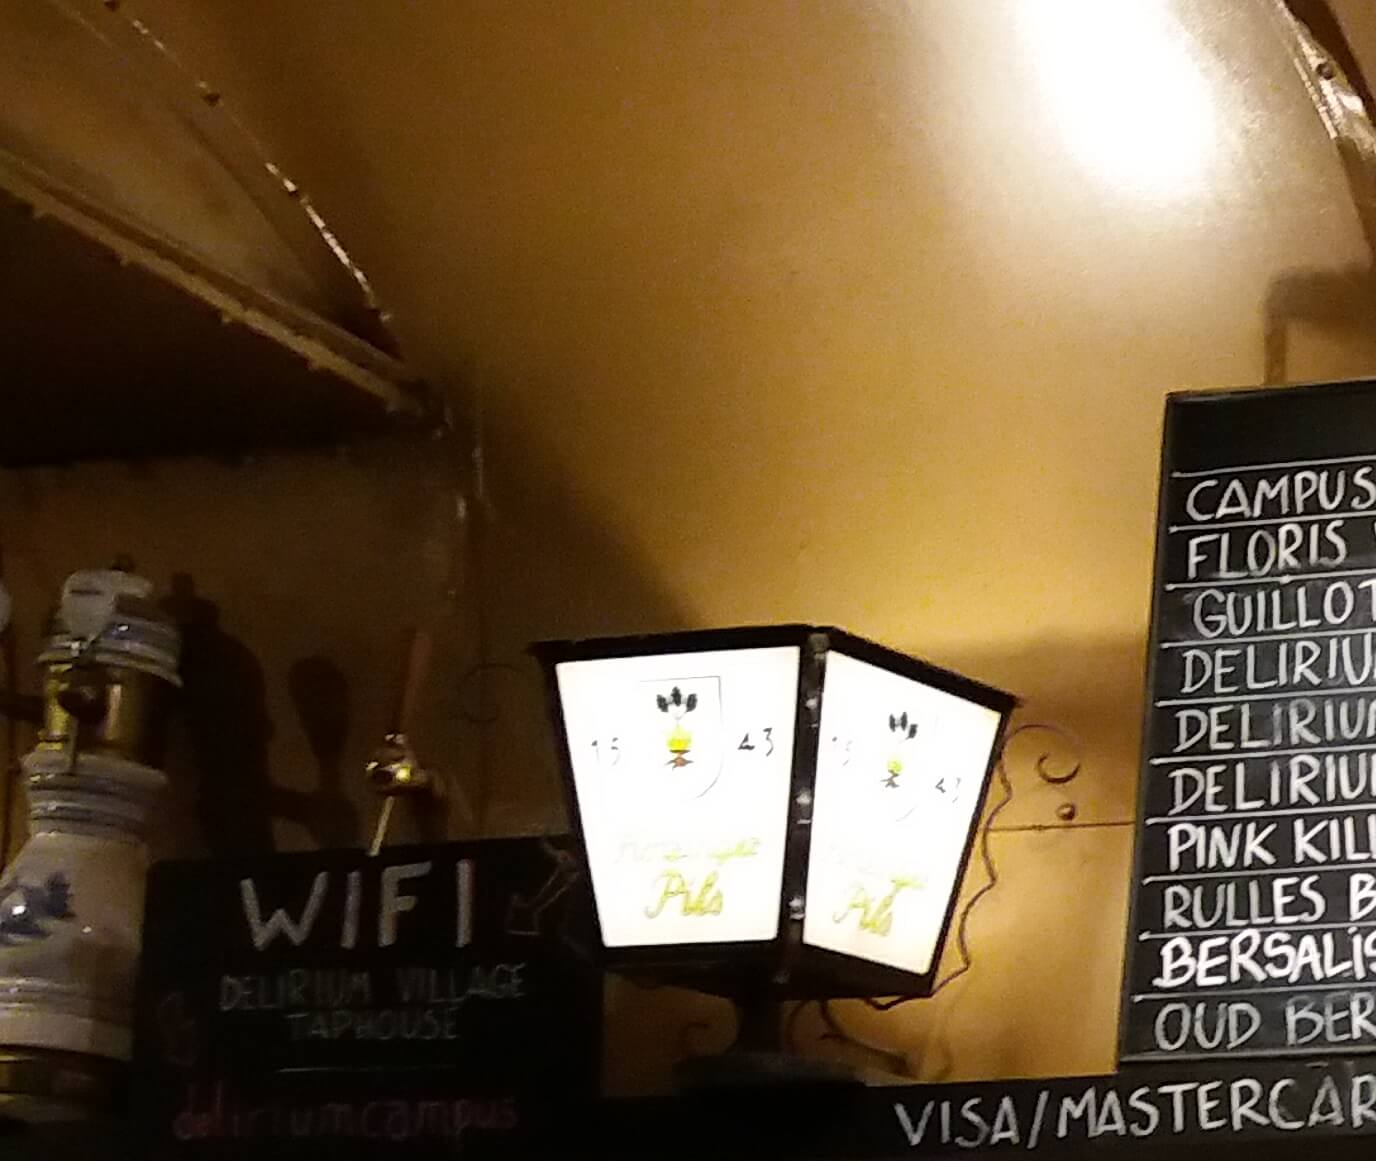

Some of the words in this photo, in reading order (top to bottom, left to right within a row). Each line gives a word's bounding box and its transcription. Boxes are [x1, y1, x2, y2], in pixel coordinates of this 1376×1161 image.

[1188, 519, 1347, 580] FLORIS
[1167, 820, 1277, 872] PINK
[240, 859, 475, 951] WIFI
[1163, 873, 1327, 930] RULLES
[219, 968, 373, 1012] DELIRIUM
[396, 961, 527, 1005] VILLAGE
[284, 1008, 461, 1041] TAPHOUSE
[1155, 1001, 1260, 1049] OUD
